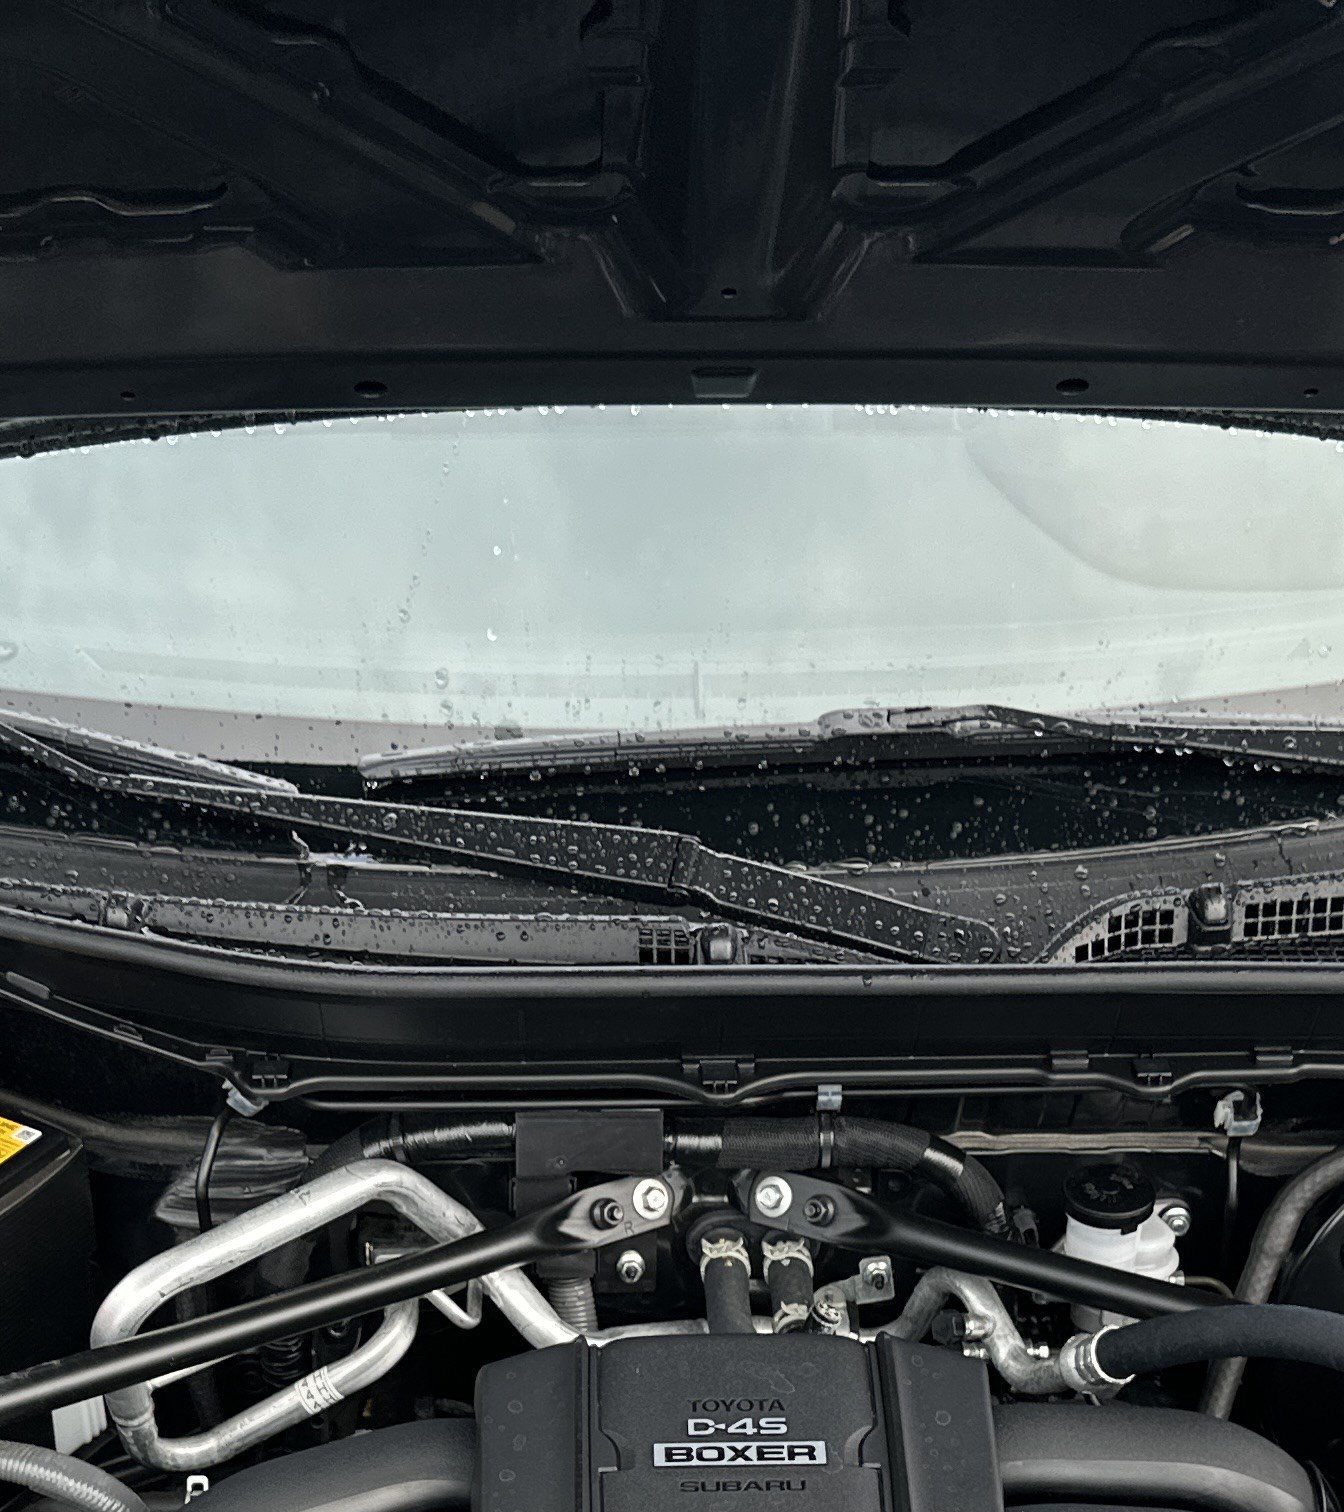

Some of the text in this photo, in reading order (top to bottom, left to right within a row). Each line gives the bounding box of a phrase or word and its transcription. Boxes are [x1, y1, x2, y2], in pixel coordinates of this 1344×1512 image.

[688, 1399, 786, 1413] TOYOTA
[664, 1444, 818, 1463] BOXER
[680, 1479, 807, 1493] SUBARU
